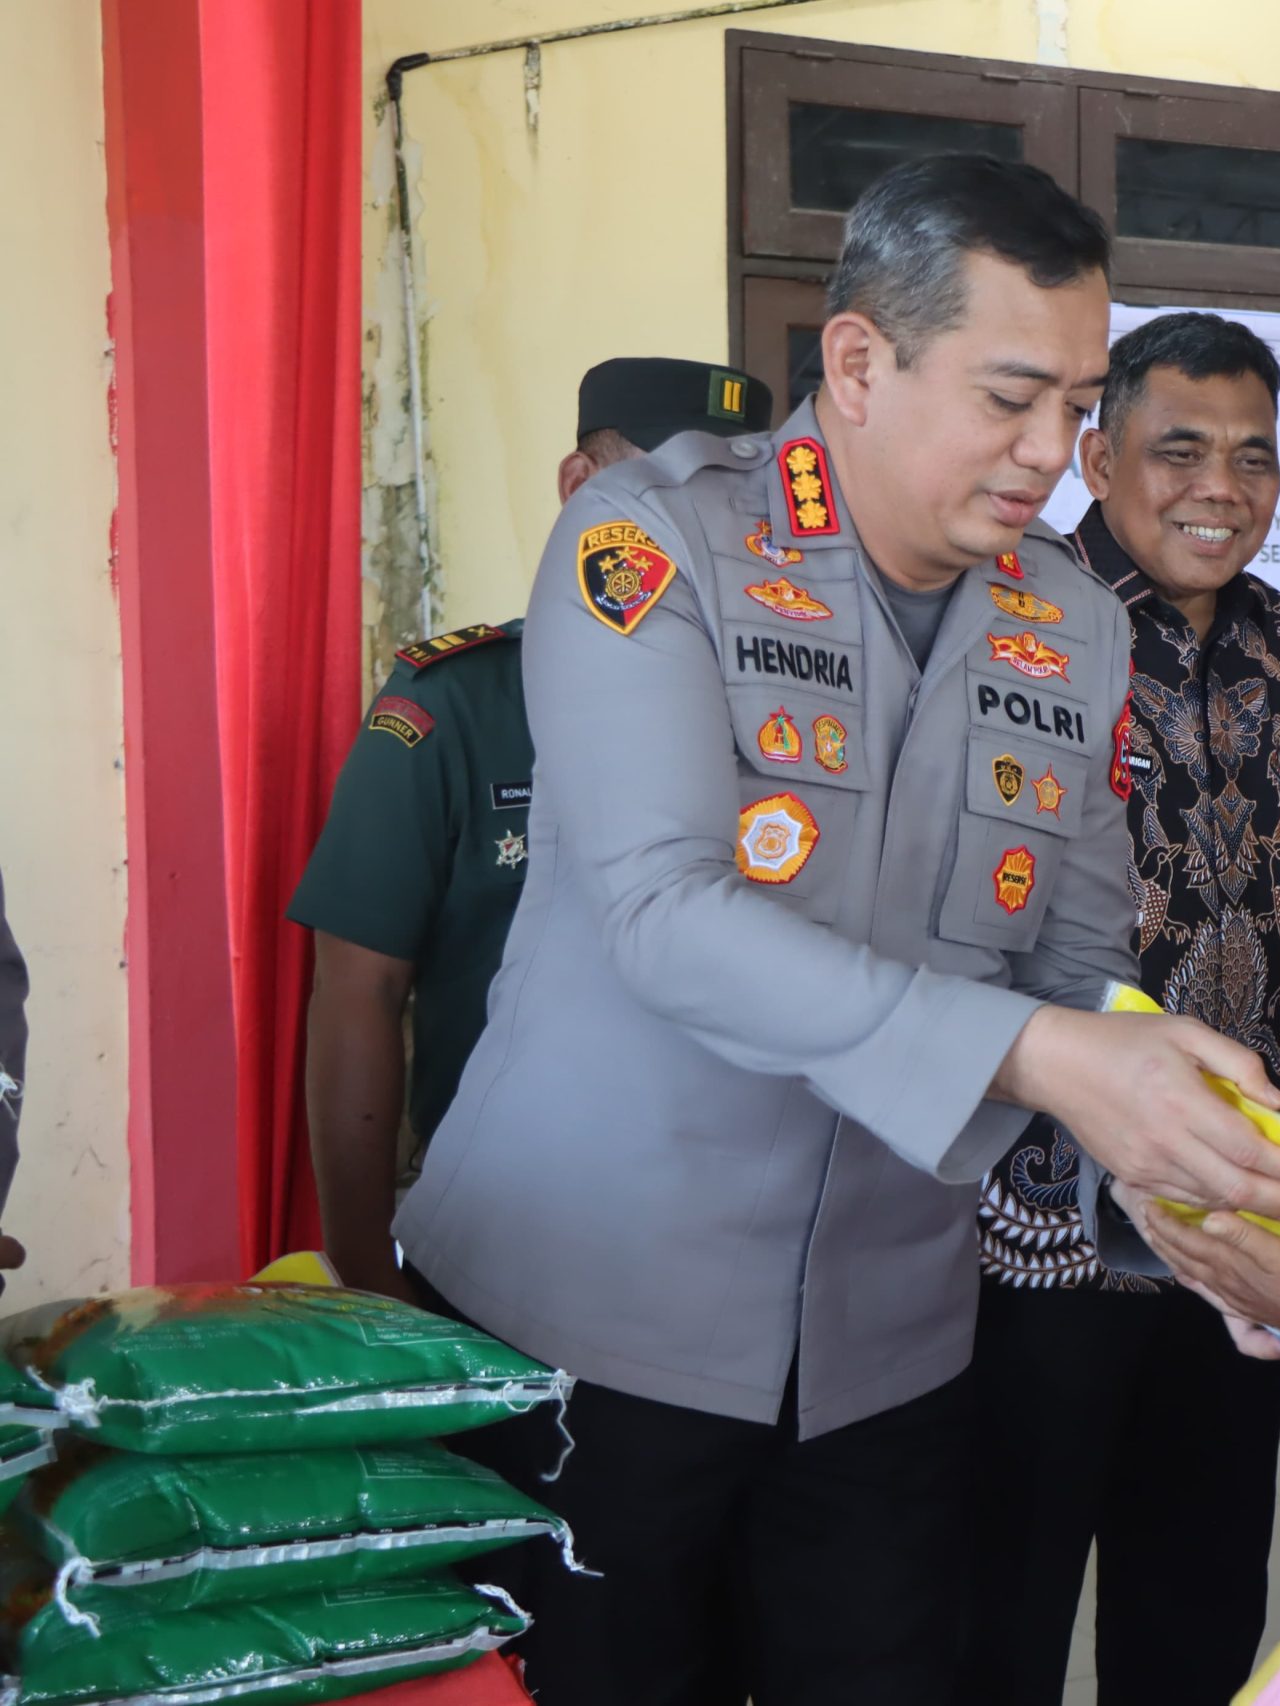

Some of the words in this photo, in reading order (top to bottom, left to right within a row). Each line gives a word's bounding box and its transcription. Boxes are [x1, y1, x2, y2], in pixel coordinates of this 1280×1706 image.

[736, 635, 853, 692] HENDRIA
[377, 716, 414, 739] GUNNER
[977, 684, 1085, 744] POLRI
